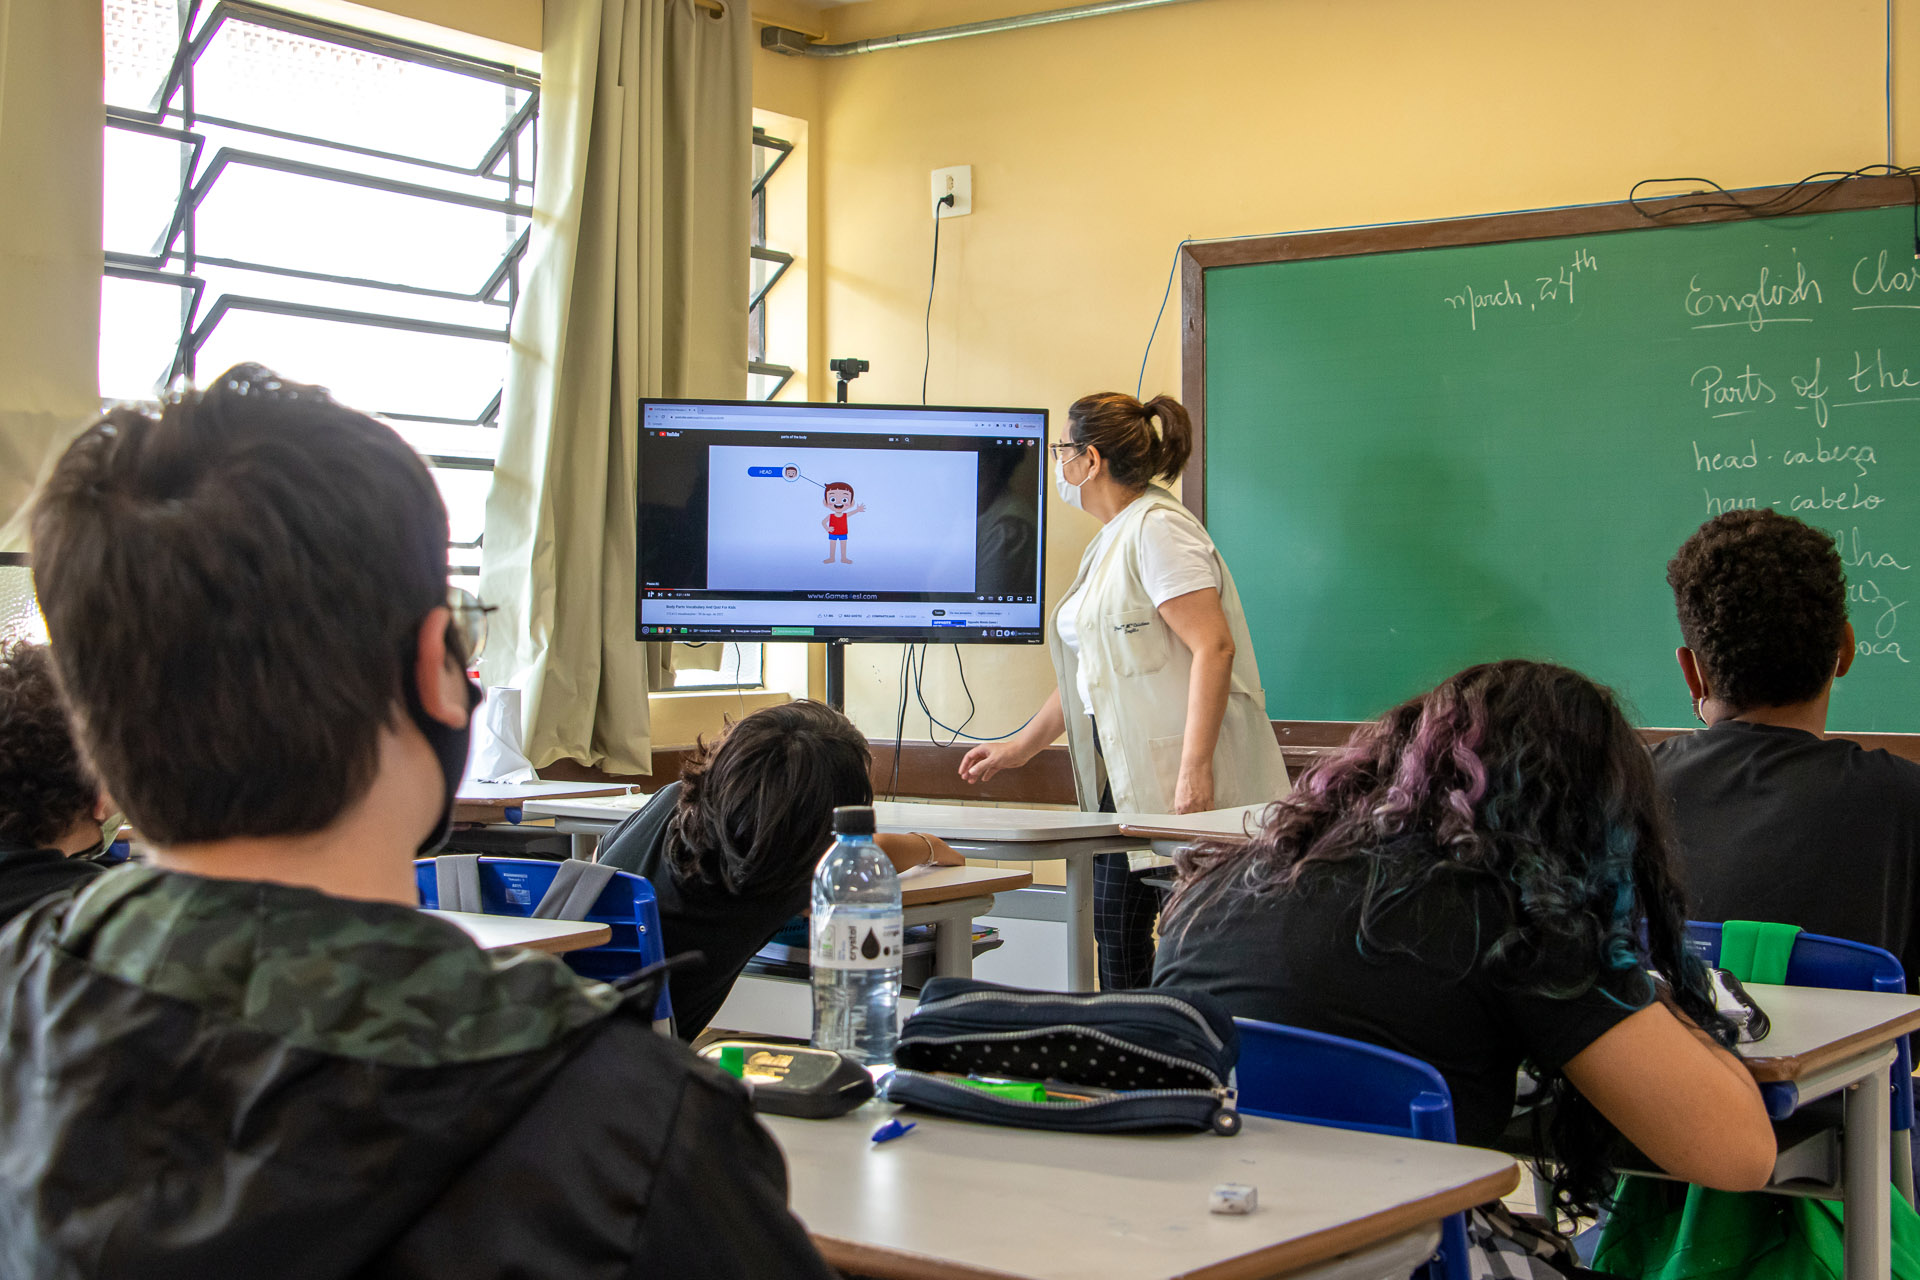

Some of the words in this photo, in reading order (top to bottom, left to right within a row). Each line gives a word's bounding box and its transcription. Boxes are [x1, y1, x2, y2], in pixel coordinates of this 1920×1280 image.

[1685, 262, 1823, 332] English
[1690, 364, 1777, 409] Parts
[1791, 357, 1829, 429] of
[1848, 348, 1920, 393] the
[1692, 439, 1758, 473] head
[1783, 437, 1877, 478] cabeça
[1790, 483, 1887, 512] cabelo
[1854, 640, 1911, 663] oca
[848, 925, 858, 961] crystal
